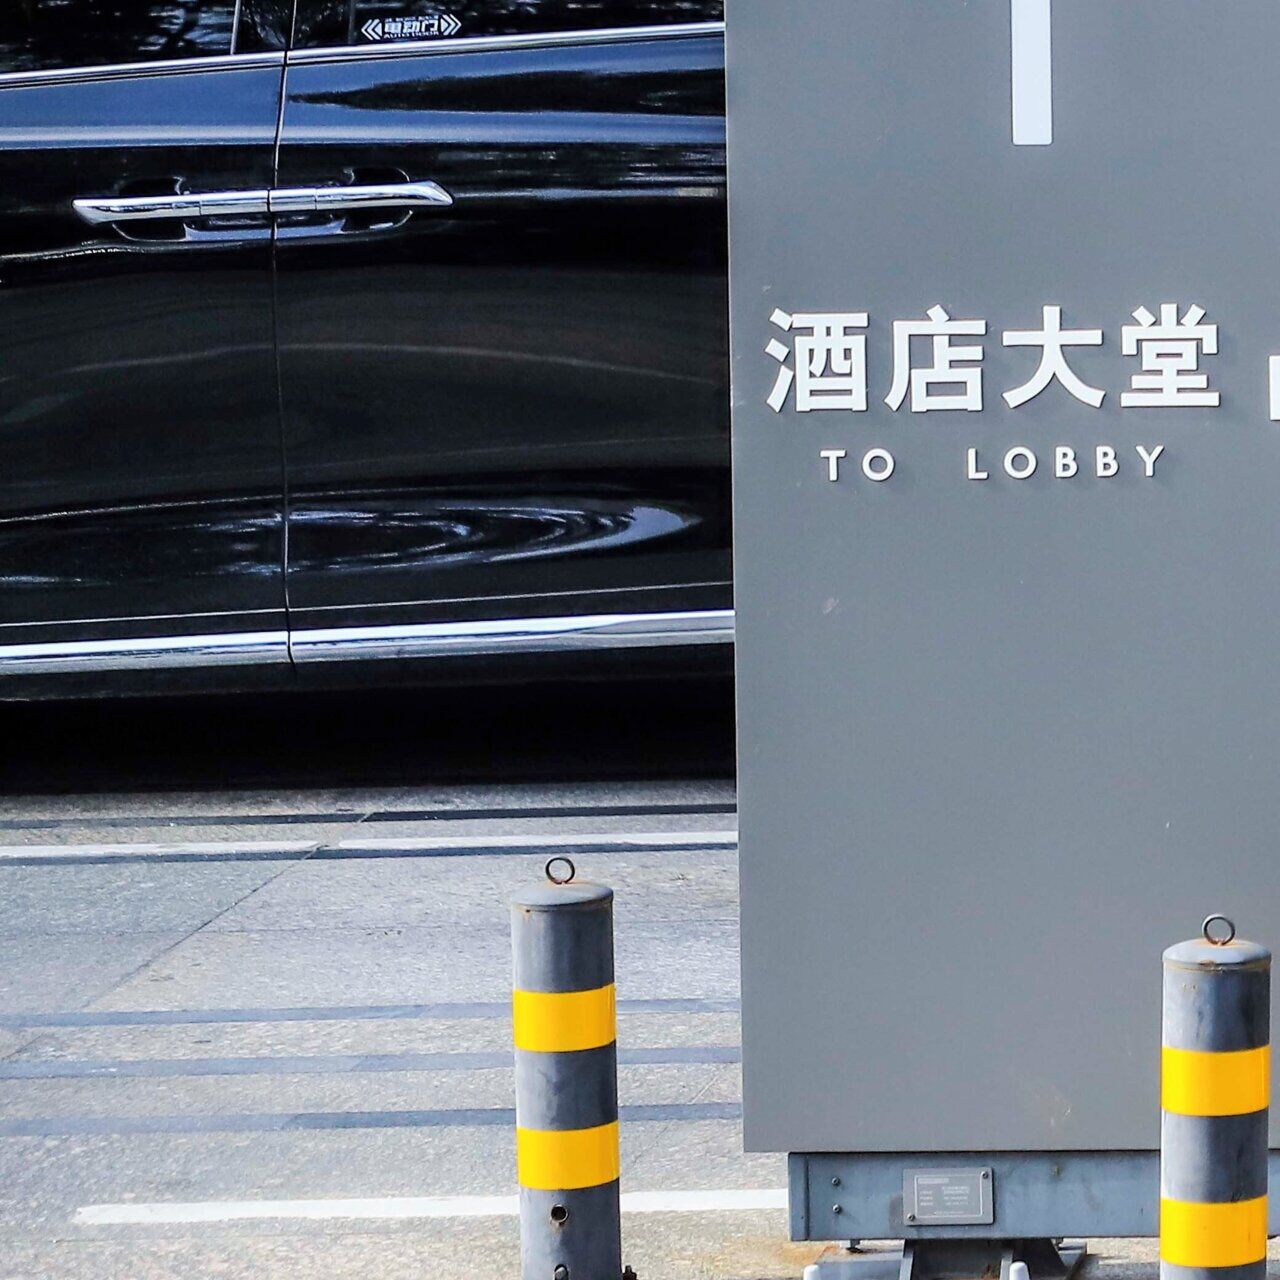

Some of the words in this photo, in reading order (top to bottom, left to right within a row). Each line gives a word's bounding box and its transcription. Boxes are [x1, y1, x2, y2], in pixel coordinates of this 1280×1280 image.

[764, 303, 1220, 413] 酒店大堂
[820, 448, 895, 482] TO
[967, 445, 1164, 480] LOBBY
